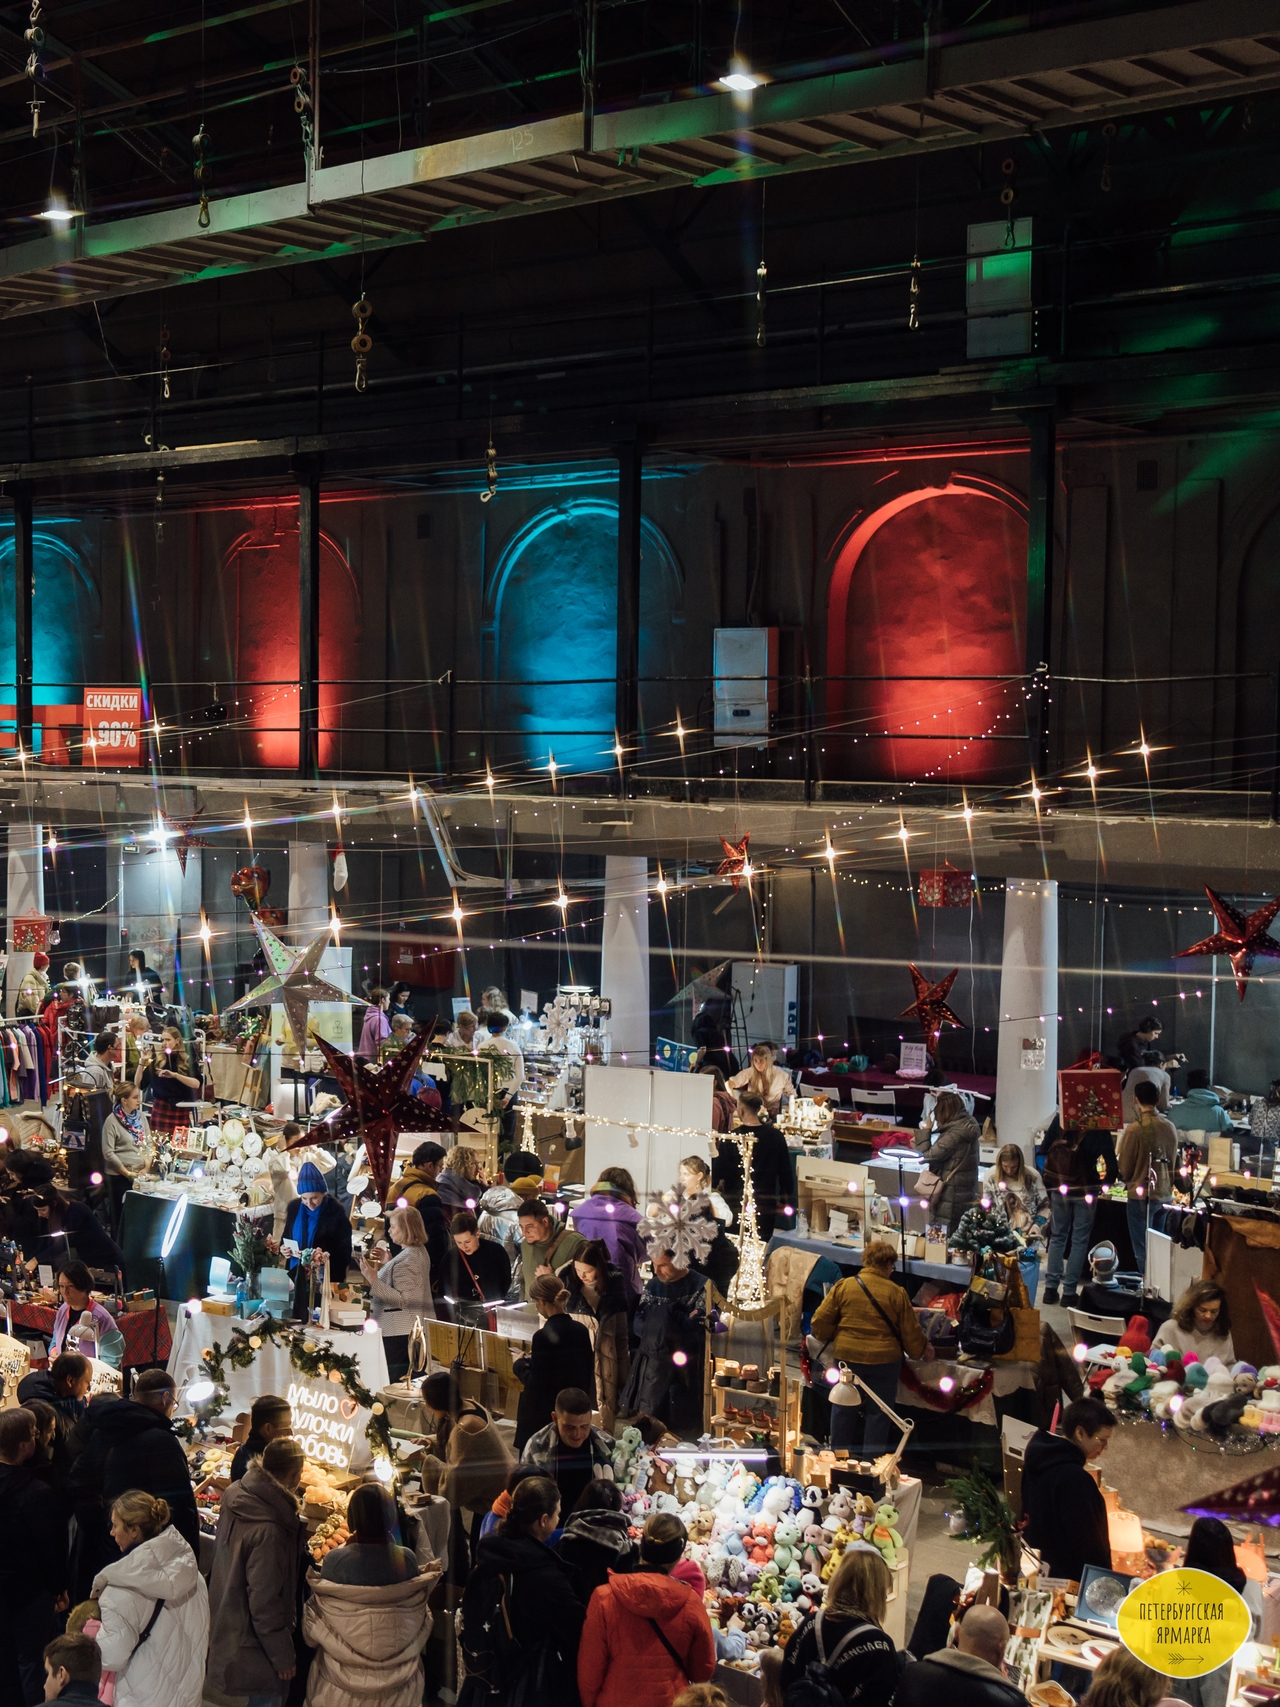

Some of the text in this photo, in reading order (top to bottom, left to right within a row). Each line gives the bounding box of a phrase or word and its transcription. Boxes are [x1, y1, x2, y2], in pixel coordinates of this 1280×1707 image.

[509, 128, 535, 156] 125
[86, 694, 138, 711] СКИДКИ
[98, 720, 137, 748] 90%
[290, 1408, 355, 1445] улочки
[290, 1433, 348, 1468] бовь
